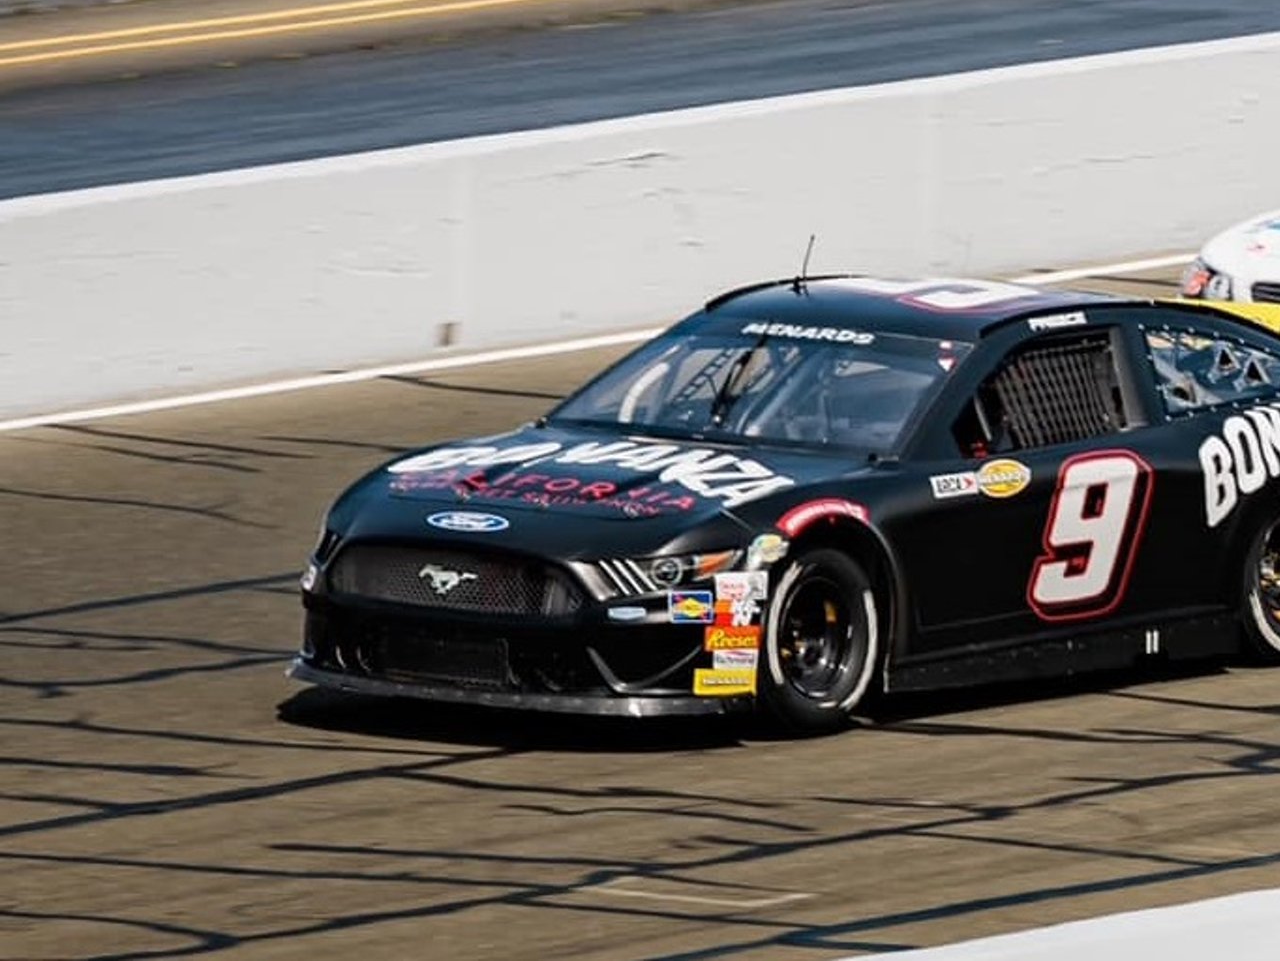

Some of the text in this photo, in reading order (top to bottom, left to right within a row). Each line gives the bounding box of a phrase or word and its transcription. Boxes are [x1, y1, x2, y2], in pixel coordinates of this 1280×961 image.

[740, 322, 876, 345] MENARDS
[387, 441, 795, 508] BONANZA
[1027, 449, 1153, 620] 9
